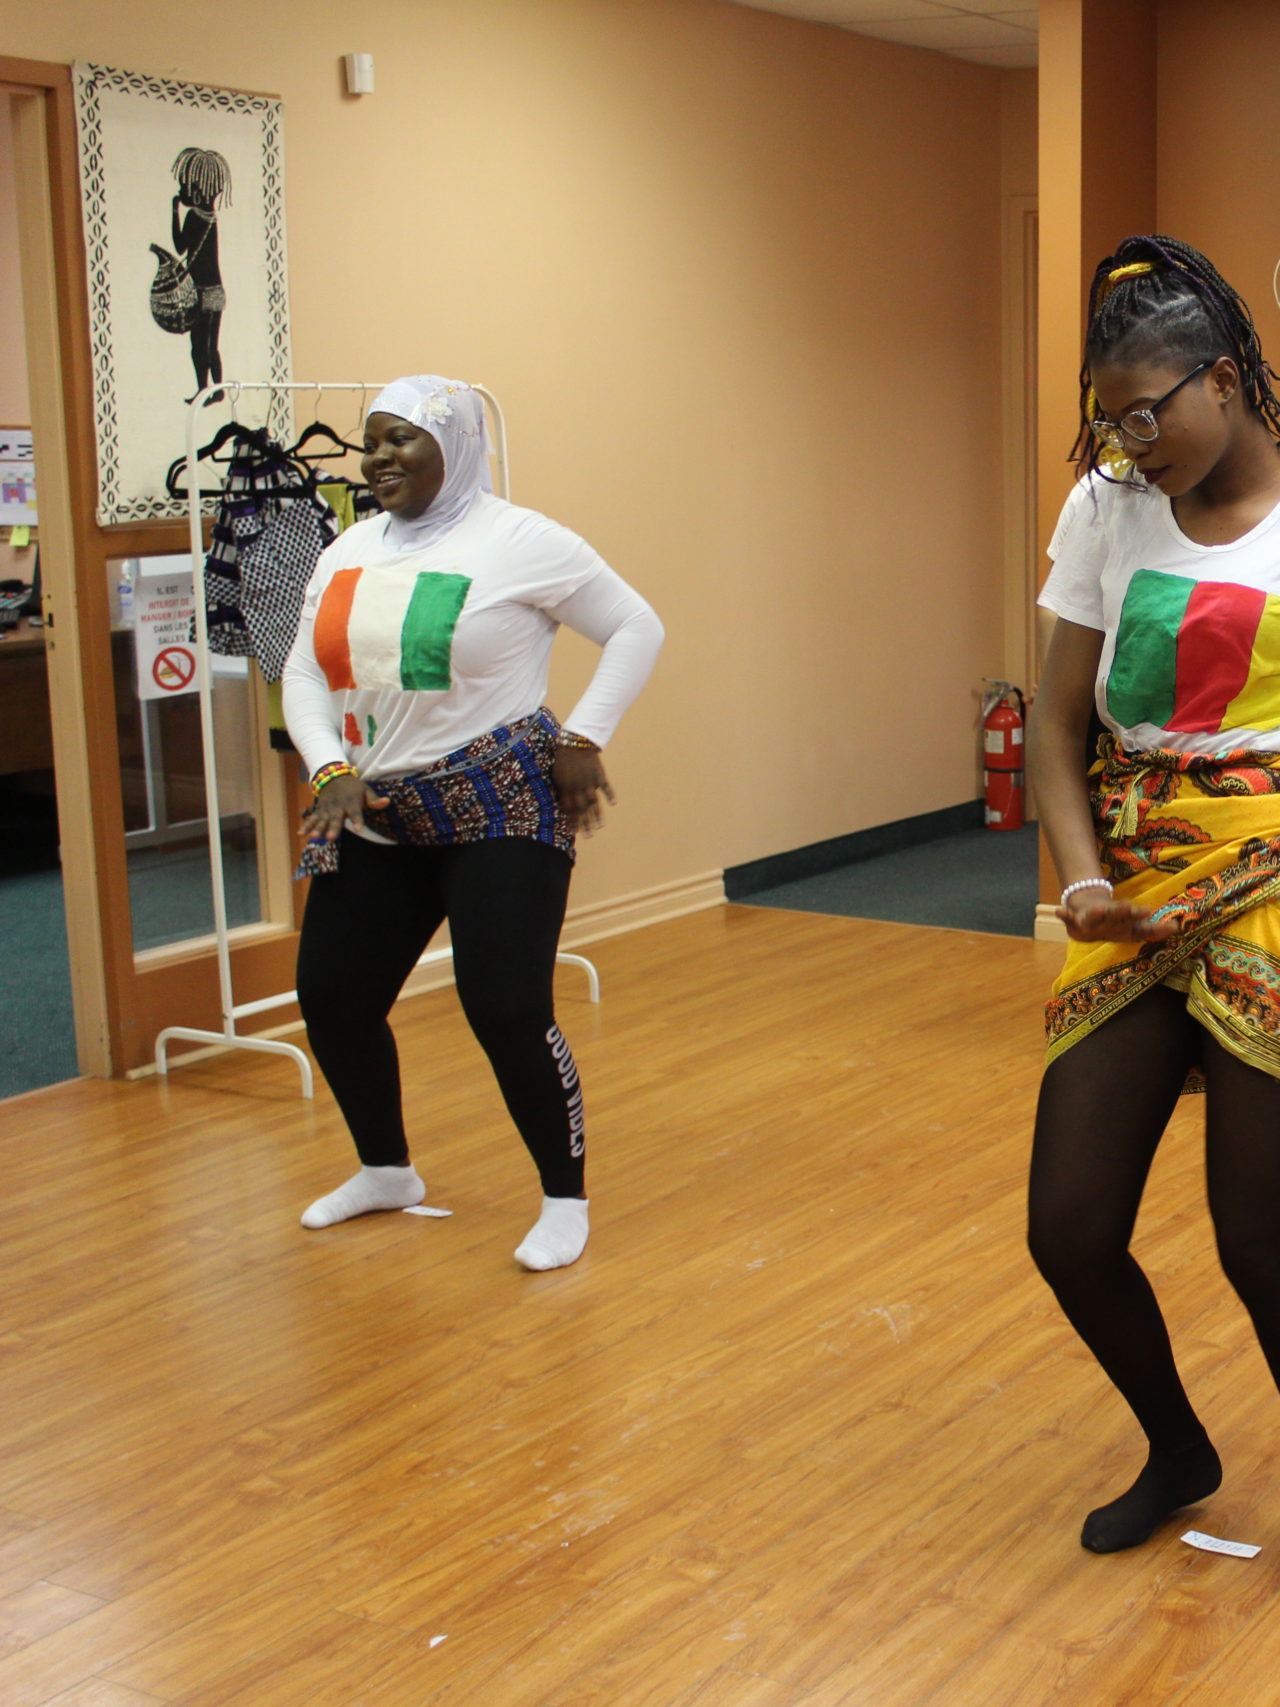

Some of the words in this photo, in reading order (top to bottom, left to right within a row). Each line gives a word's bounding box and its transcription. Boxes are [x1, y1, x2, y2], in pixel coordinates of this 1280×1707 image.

[165, 585, 178, 594] EST
[148, 598, 179, 610] INTERDIT
[180, 597, 189, 606] DE
[141, 611, 172, 622] MANGER
[153, 623, 173, 633] DANS
[174, 622, 188, 631] LES
[158, 634, 186, 645] SALLES
